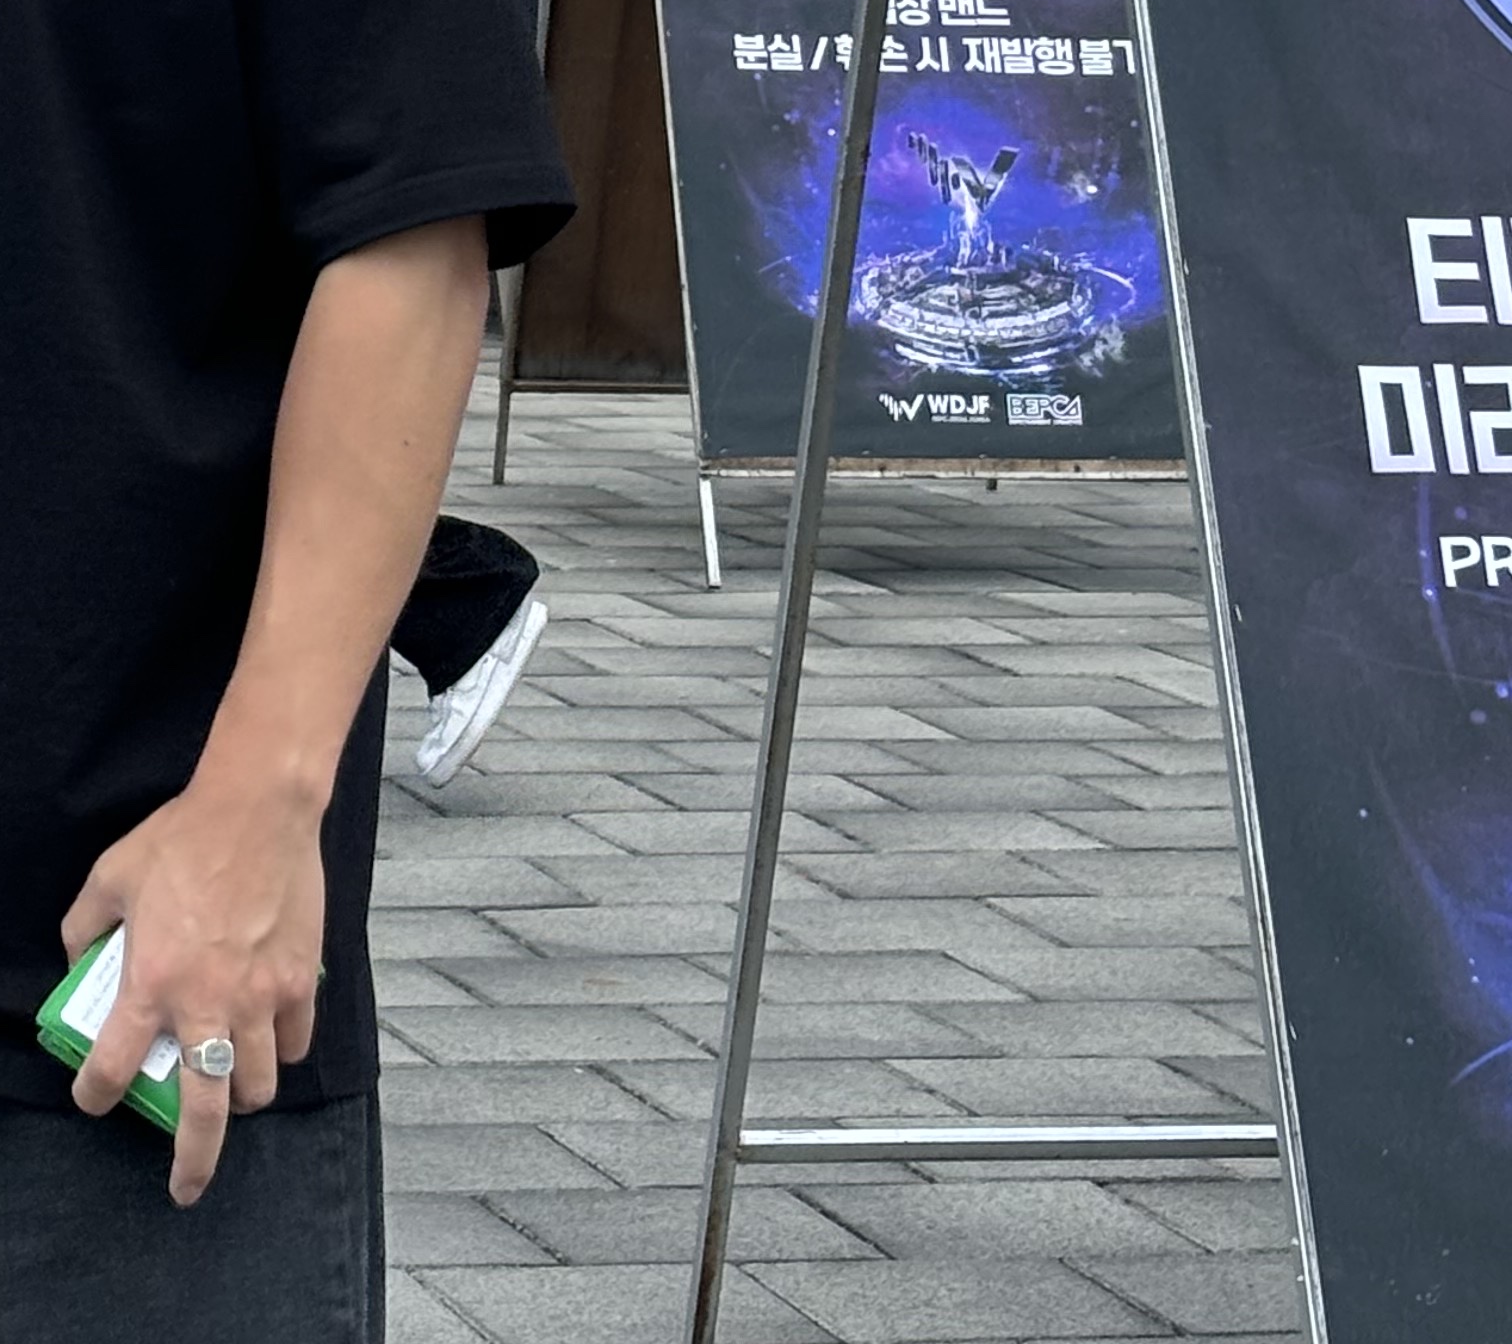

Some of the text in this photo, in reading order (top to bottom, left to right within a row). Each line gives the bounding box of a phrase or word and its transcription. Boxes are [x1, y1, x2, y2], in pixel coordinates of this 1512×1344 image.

[733, 33, 804, 72] 분실
[915, 36, 951, 73] 시
[961, 36, 1076, 76] 재발행
[1406, 216, 1512, 325] 티
[927, 393, 991, 415] WDJF
